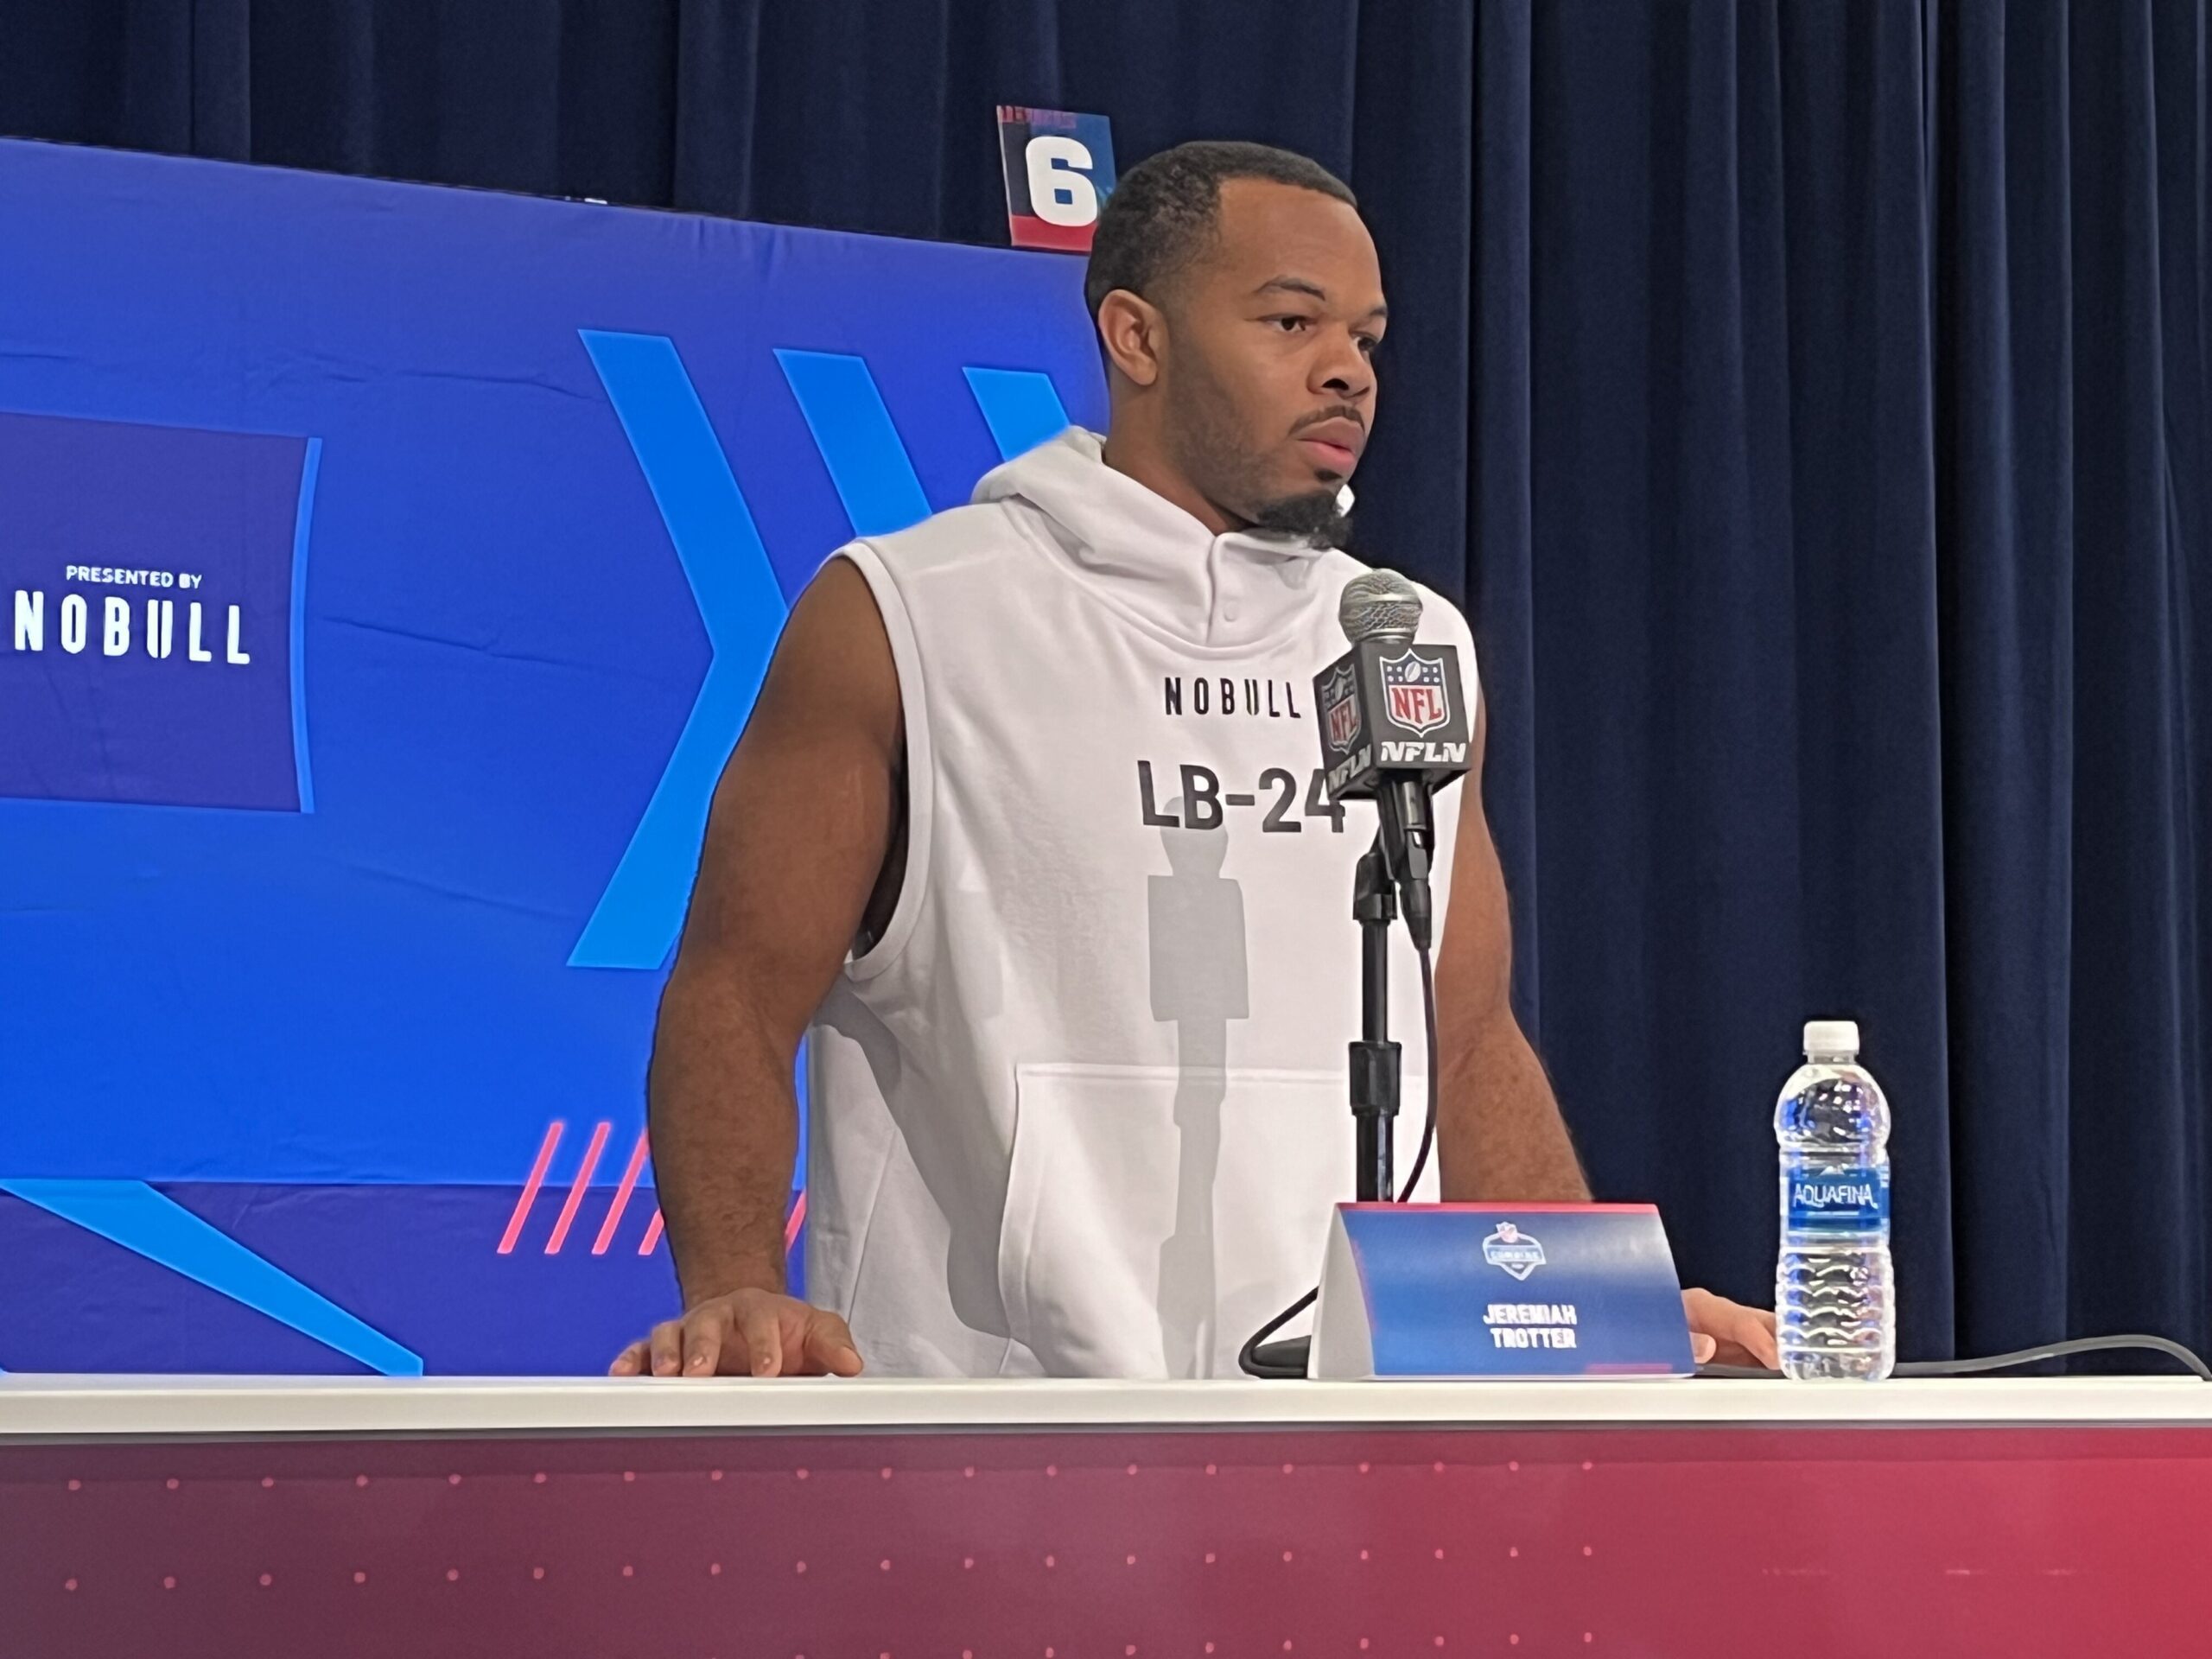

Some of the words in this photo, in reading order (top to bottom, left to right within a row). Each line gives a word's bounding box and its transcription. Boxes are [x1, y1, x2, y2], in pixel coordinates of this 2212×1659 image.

[1026, 137, 1097, 226] 6
[66, 565, 173, 588] PRESENTED
[179, 573, 202, 588] BY
[15, 589, 250, 664] NOBULL
[1165, 677, 1301, 718] NOBULL
[1391, 688, 1441, 724] NFL
[1331, 702, 1357, 741] NFL
[1381, 741, 1466, 763] NFLN
[1137, 760, 1344, 834] LB-24
[1793, 1183, 1878, 1209] AQUAFINA
[1483, 1304, 1578, 1325] JEREMIAH
[1490, 1328, 1577, 1349] TROTTER
